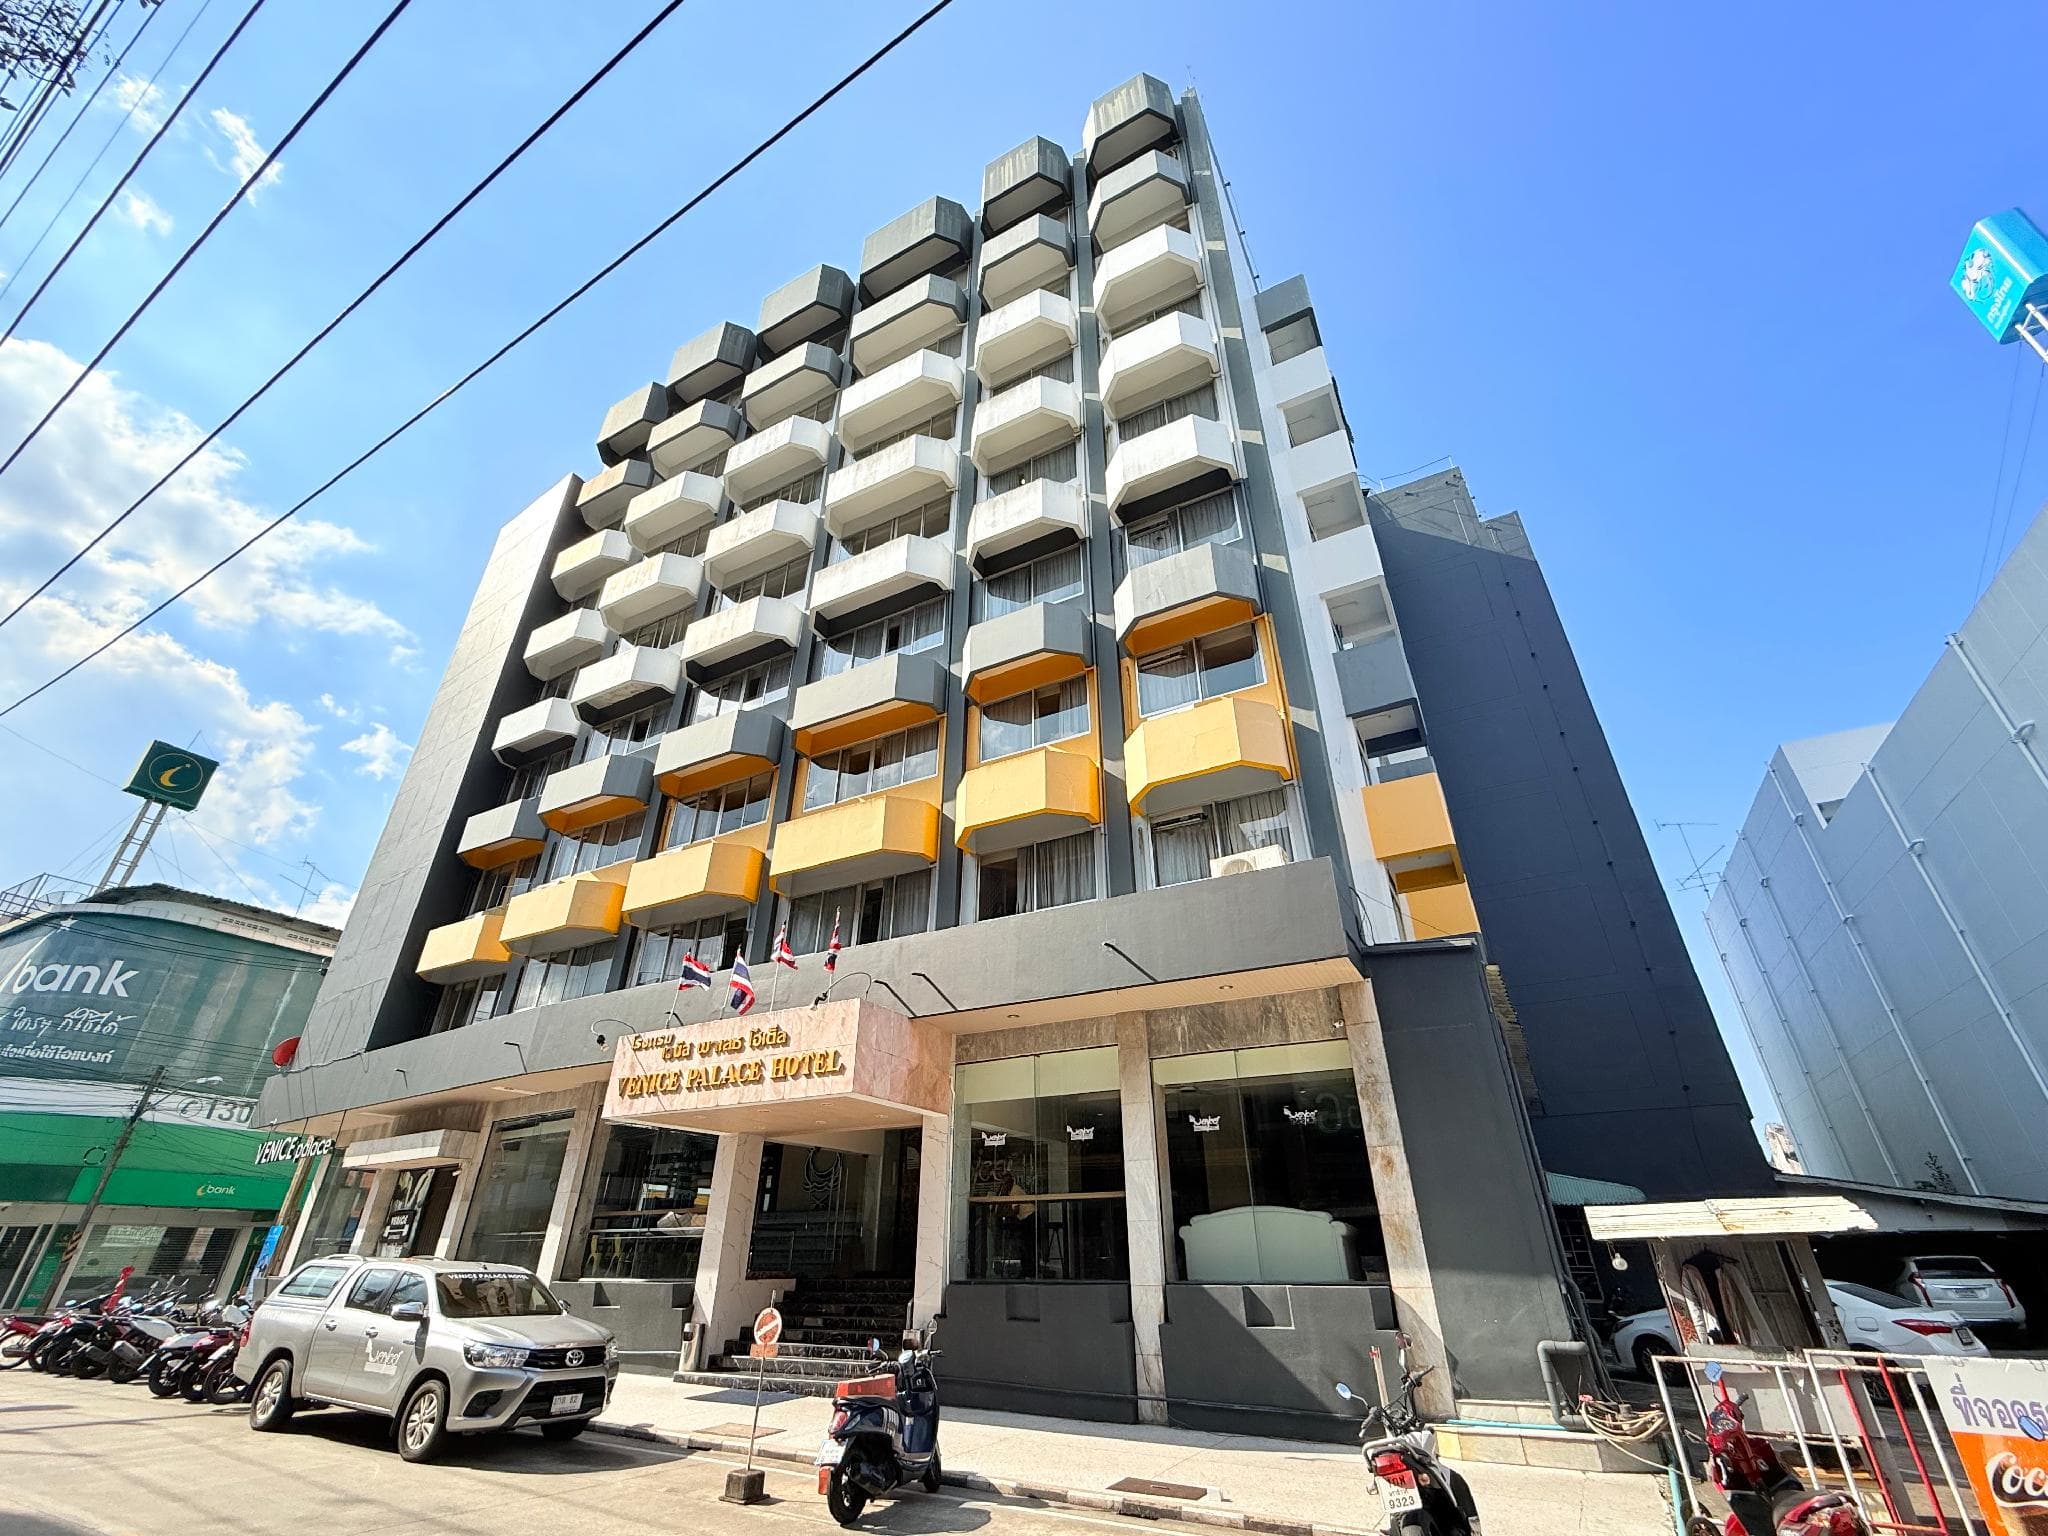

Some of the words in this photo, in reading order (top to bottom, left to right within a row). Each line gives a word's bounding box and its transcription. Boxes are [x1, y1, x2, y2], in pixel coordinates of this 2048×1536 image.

[632, 1034, 674, 1050] โรงแรม
[618, 1070, 680, 1098] VENICE
[685, 1059, 762, 1089] PALACE
[770, 1049, 843, 1080] HOTEL
[255, 1136, 299, 1165] VENICE
[293, 1135, 335, 1162] palace
[1950, 1373, 2048, 1431] ที่จอดร
[1985, 1452, 2048, 1502] Coc
[1389, 1495, 1415, 1509] 9323
